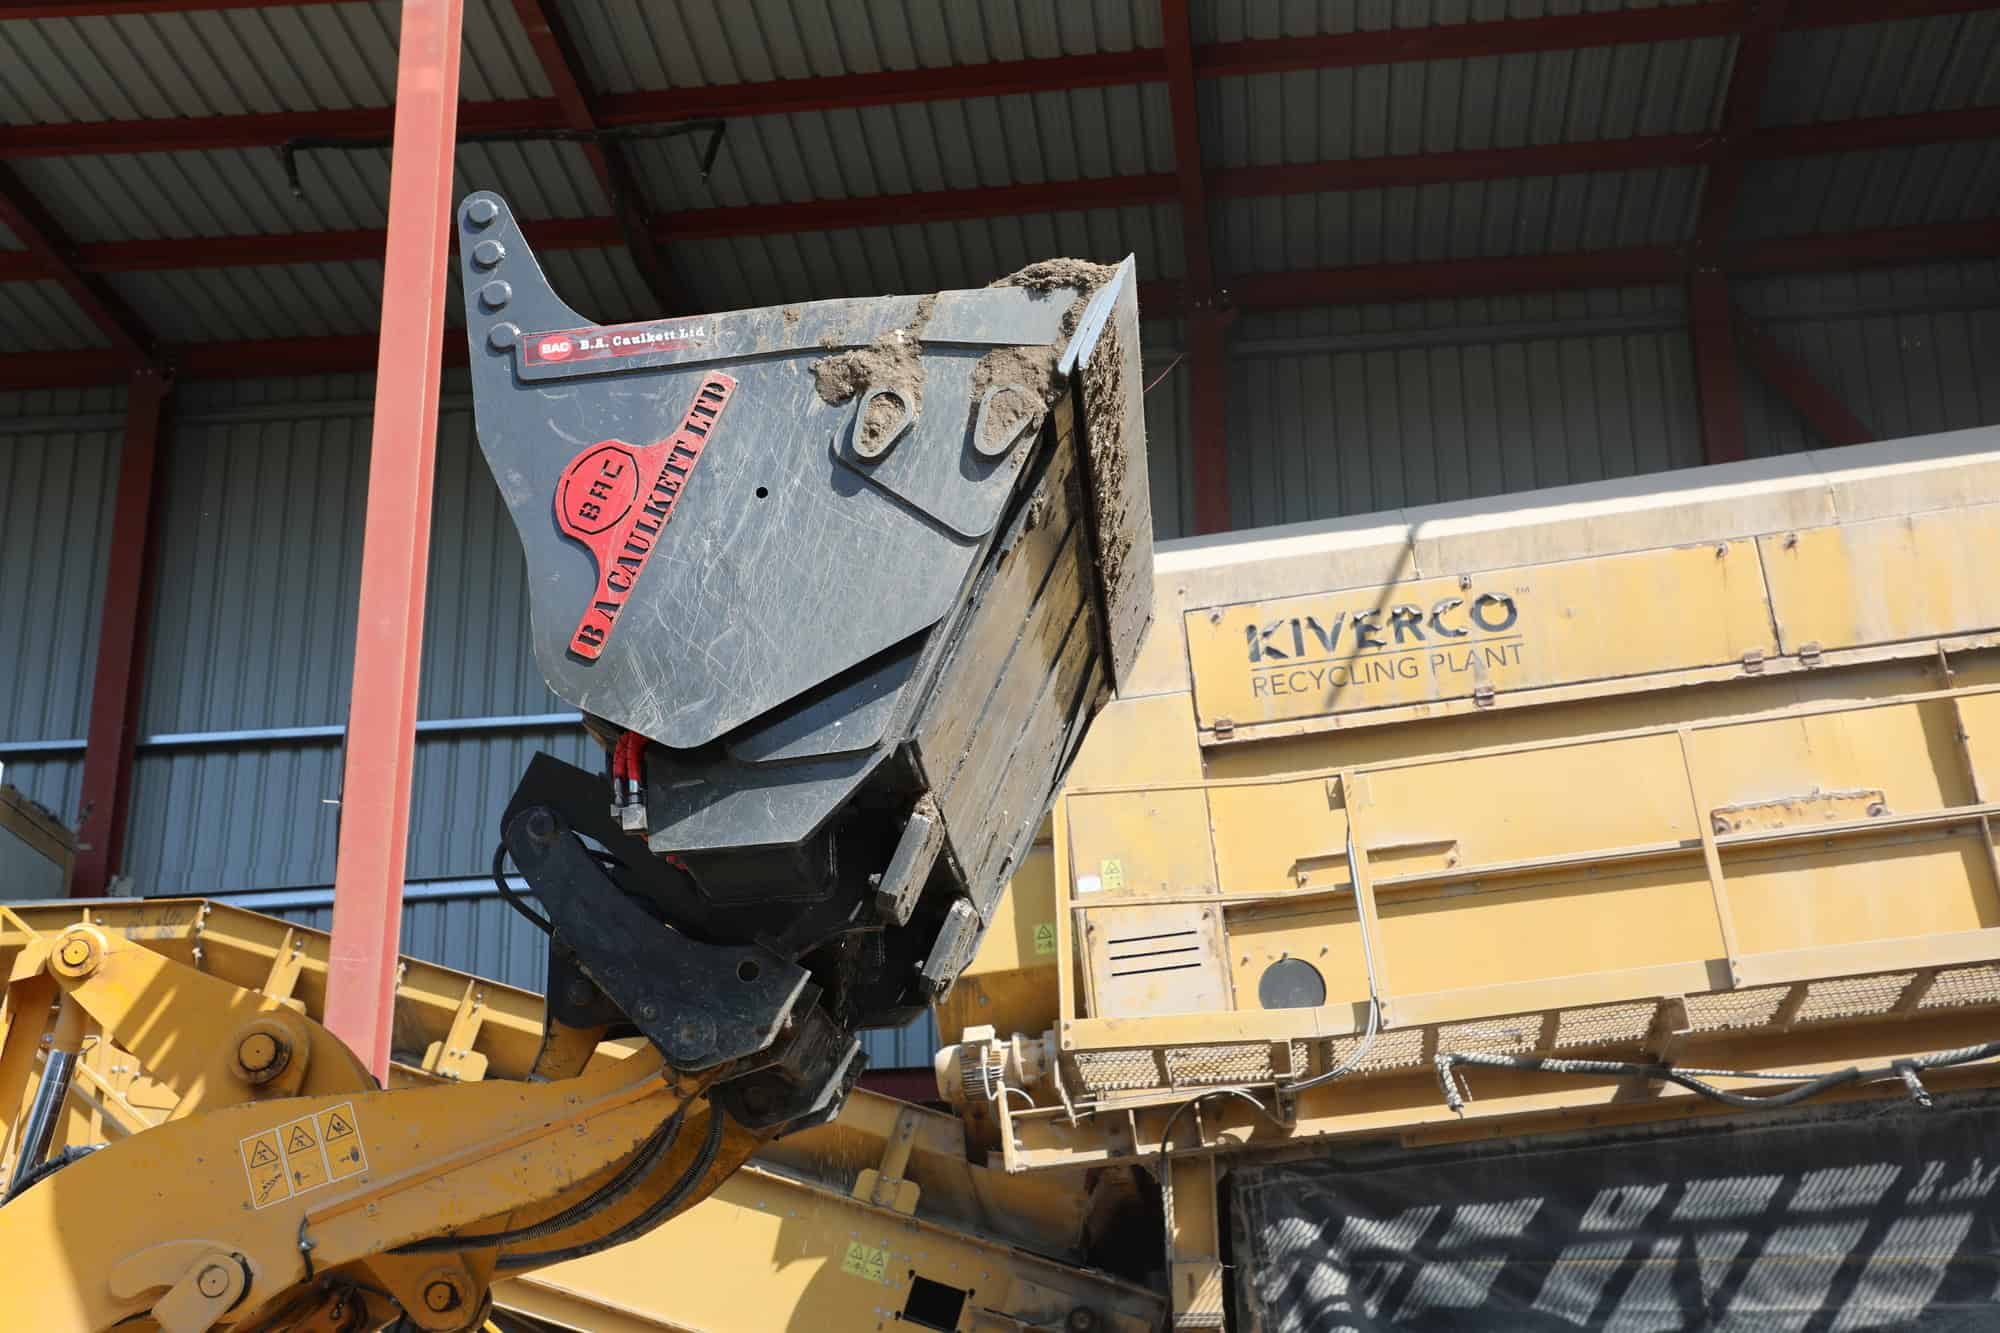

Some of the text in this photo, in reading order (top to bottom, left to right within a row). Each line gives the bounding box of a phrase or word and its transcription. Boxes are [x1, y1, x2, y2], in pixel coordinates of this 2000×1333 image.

[541, 342, 569, 354] BAC
[580, 337, 609, 350] B.A.
[612, 330, 677, 347] Caulkett
[679, 326, 705, 339] Ltd
[575, 381, 727, 649] B A CAULKETT LTD
[578, 459, 624, 522] BAC
[1245, 592, 1518, 663] KIVERCO
[1251, 643, 1525, 698] RECYCLING PLANT
